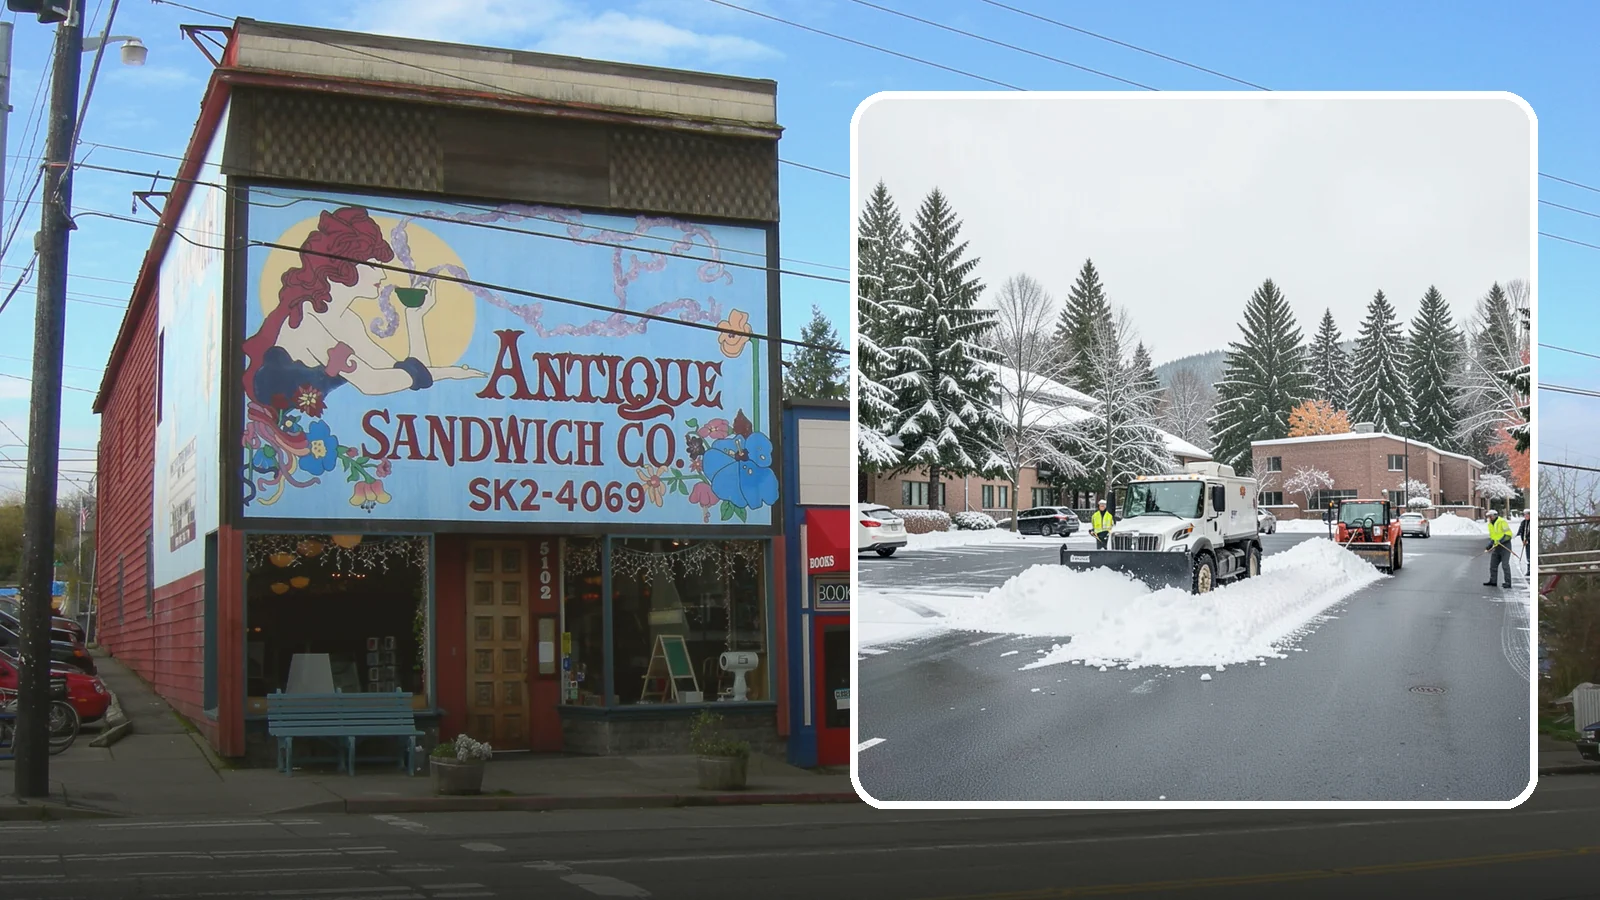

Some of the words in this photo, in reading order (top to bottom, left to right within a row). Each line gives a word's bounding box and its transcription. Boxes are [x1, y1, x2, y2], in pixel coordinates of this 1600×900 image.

[476, 329, 723, 421] ANTIQUE
[361, 408, 604, 467] SANDWICH
[617, 421, 685, 468] CO.
[468, 478, 646, 512] SK2-4069
[540, 541, 551, 600] 5102
[809, 555, 835, 569] BOOKS
